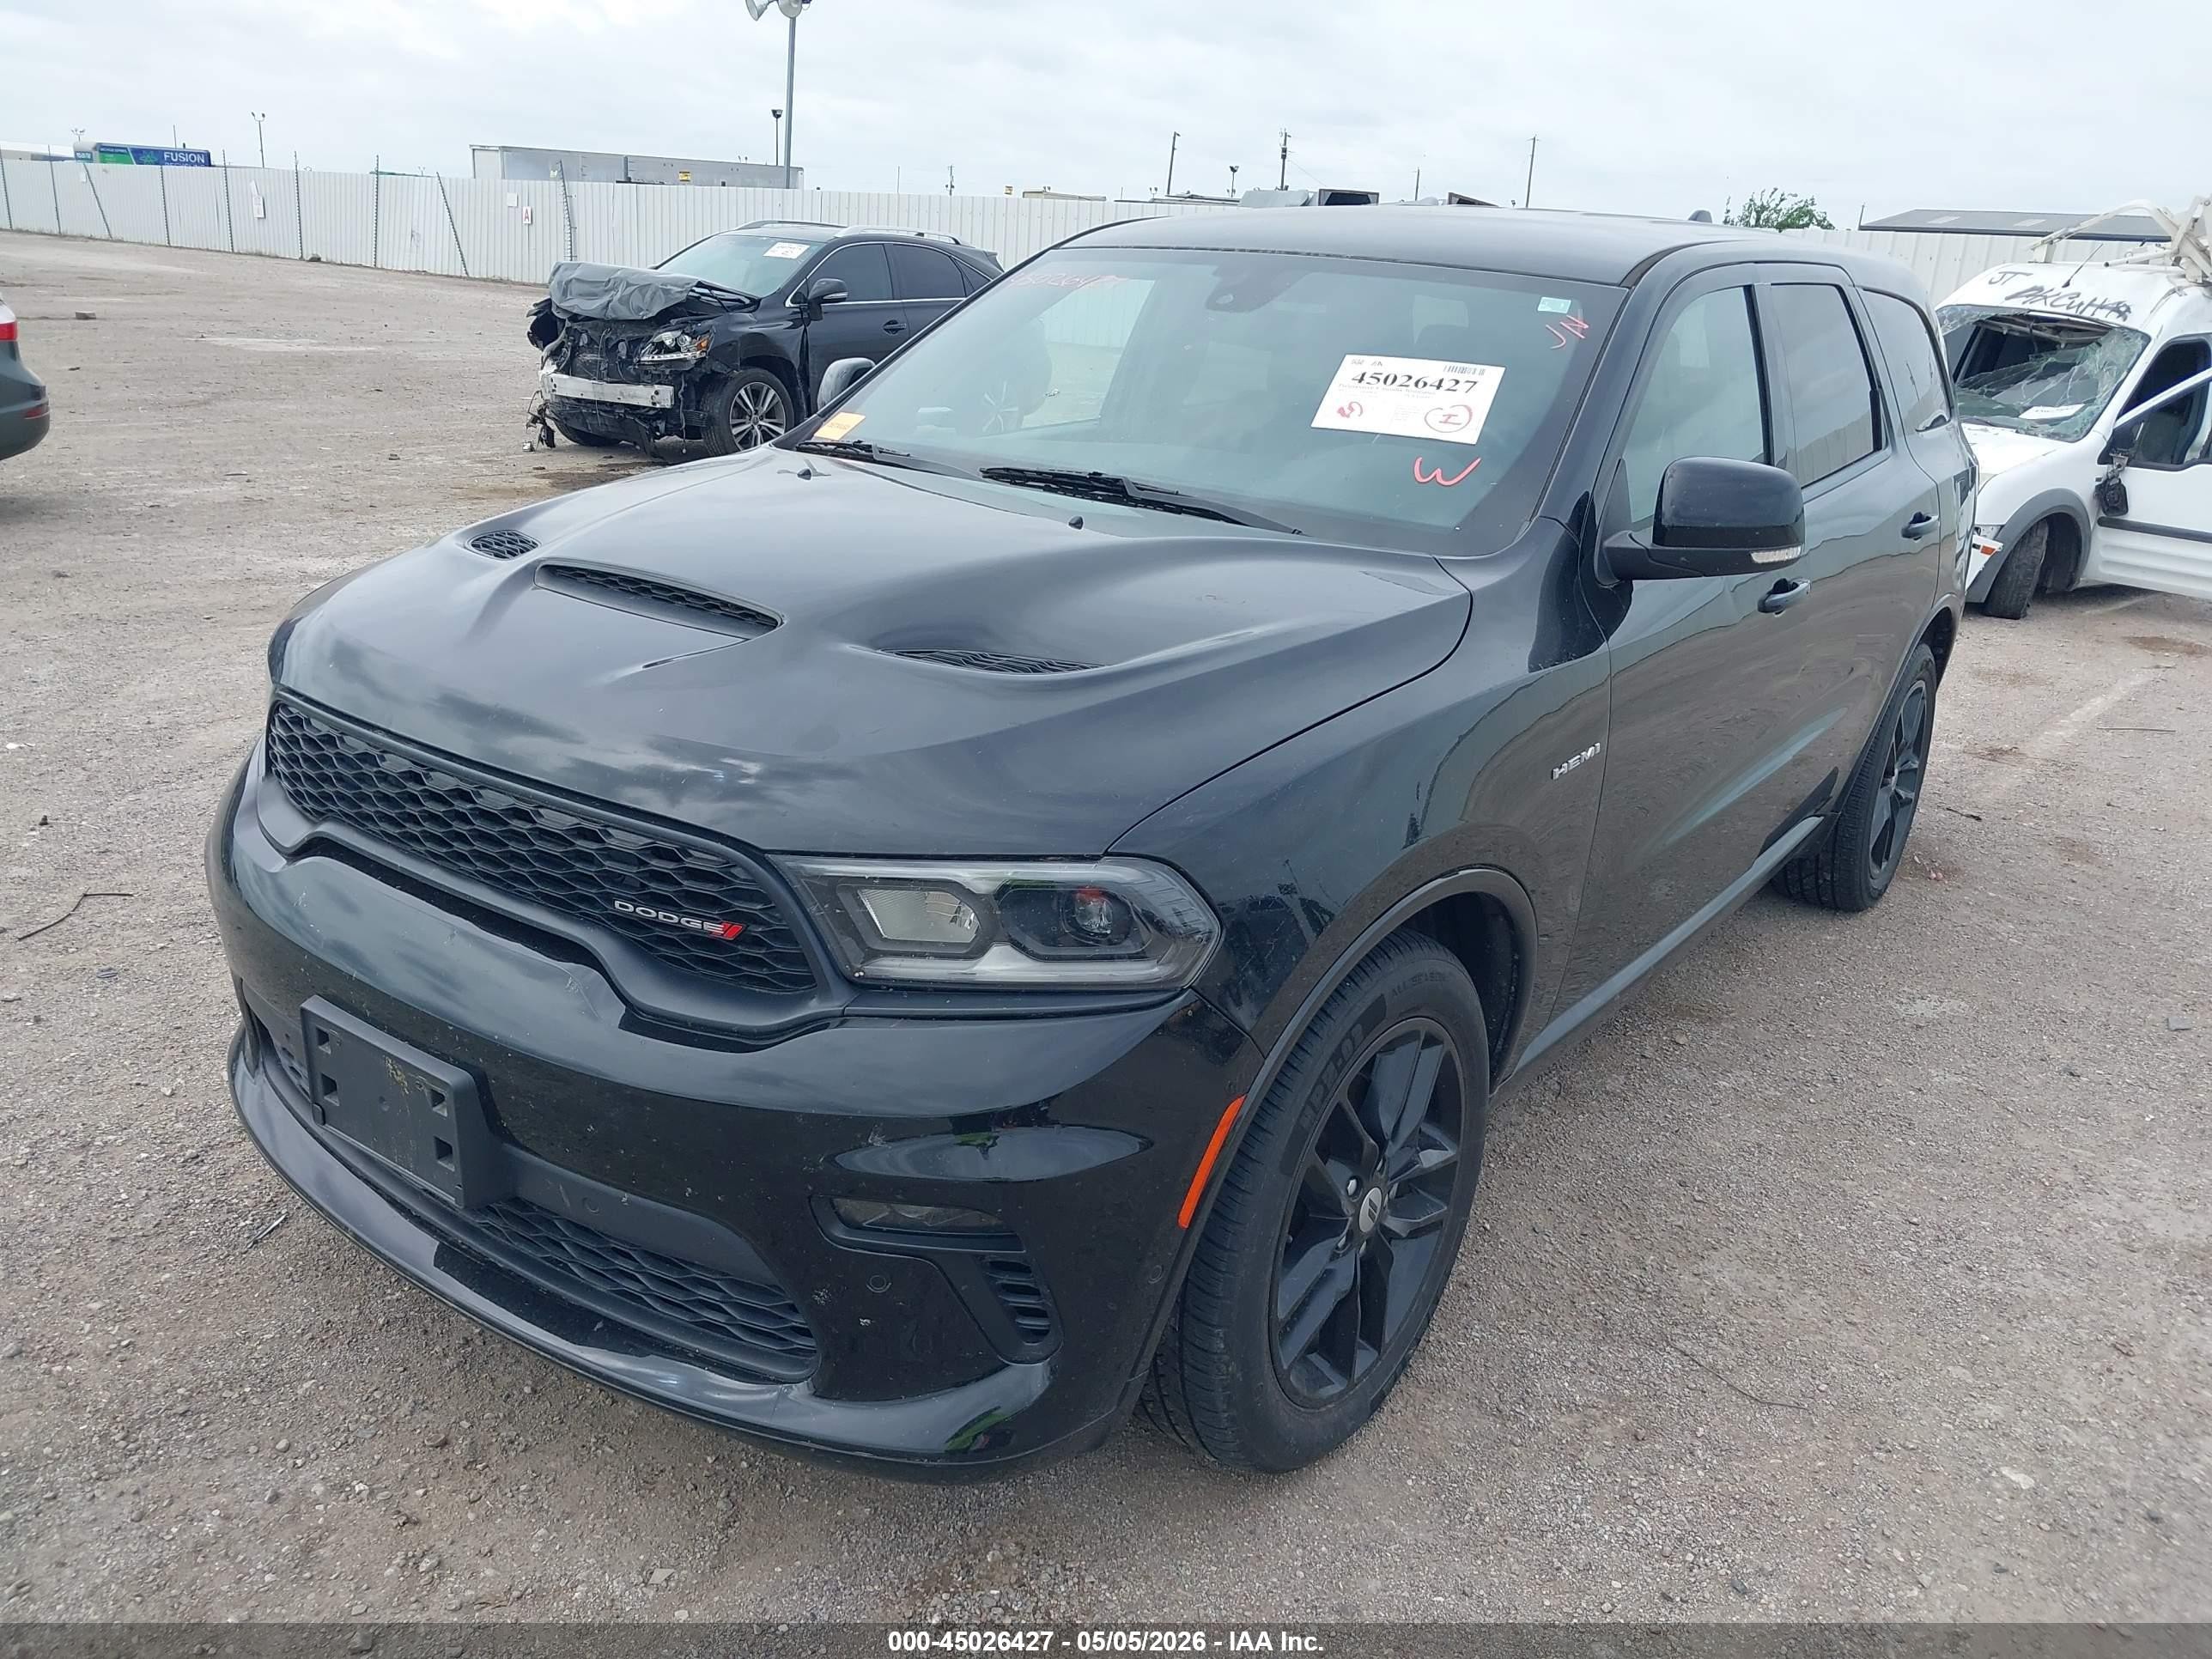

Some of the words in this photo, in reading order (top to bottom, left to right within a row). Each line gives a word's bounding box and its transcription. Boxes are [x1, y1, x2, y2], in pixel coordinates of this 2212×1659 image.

[163, 151, 205, 164] FUSION
[524, 208, 530, 222] A
[1351, 371, 1479, 393] 45026427
[1553, 742, 1601, 781] HEMI
[614, 900, 725, 934] DODGE
